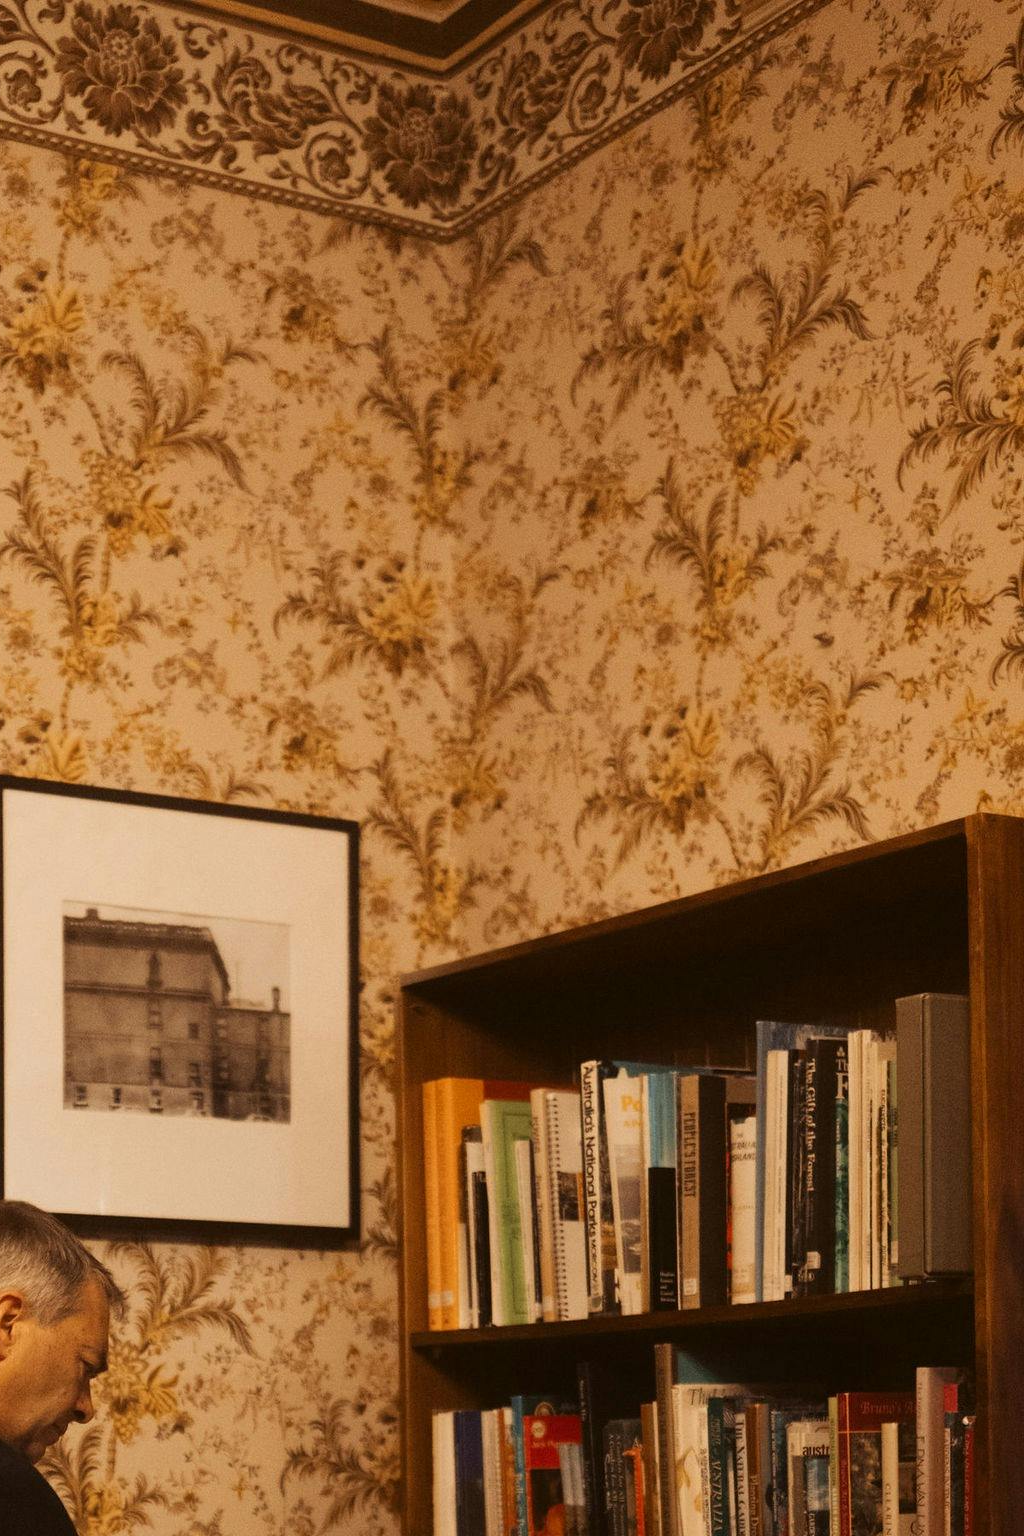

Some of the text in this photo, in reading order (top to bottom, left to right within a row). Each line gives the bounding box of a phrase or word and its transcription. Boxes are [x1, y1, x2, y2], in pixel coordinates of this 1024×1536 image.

[583, 1066, 595, 1133] Australia's
[805, 1058, 817, 1191] The Gift of the Forest
[585, 1137, 596, 1197] National
[684, 1112, 697, 1198] PEOPLE'S FOREST
[588, 1201, 598, 1237] Parks
[749, 1474, 759, 1515] Planting
